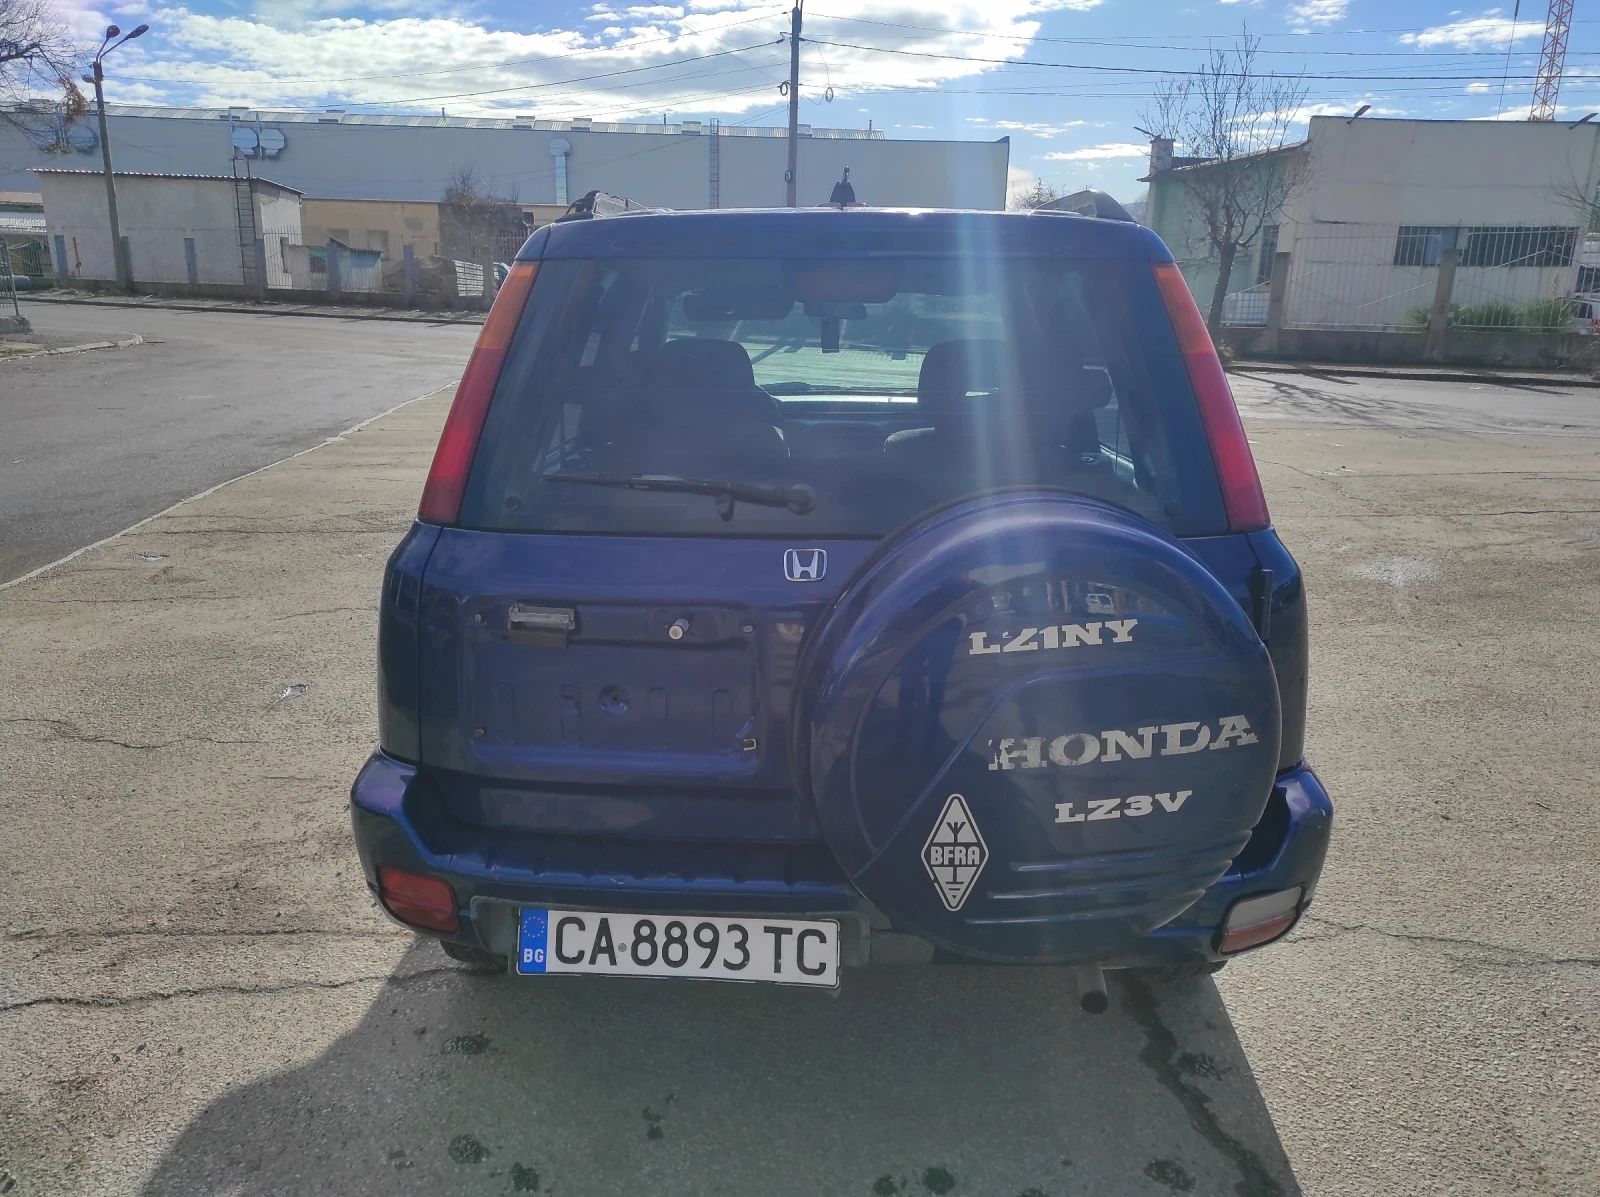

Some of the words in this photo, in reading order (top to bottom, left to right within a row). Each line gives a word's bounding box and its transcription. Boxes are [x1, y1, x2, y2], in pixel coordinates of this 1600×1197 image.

[969, 619, 1138, 655] LZ1NY
[988, 714, 1259, 770] HONDA
[1055, 790, 1192, 823] LZ3V
[930, 846, 980, 865] BFRA
[523, 948, 544, 963] BG
[631, 919, 750, 971] 8893
[764, 926, 827, 976] TC
